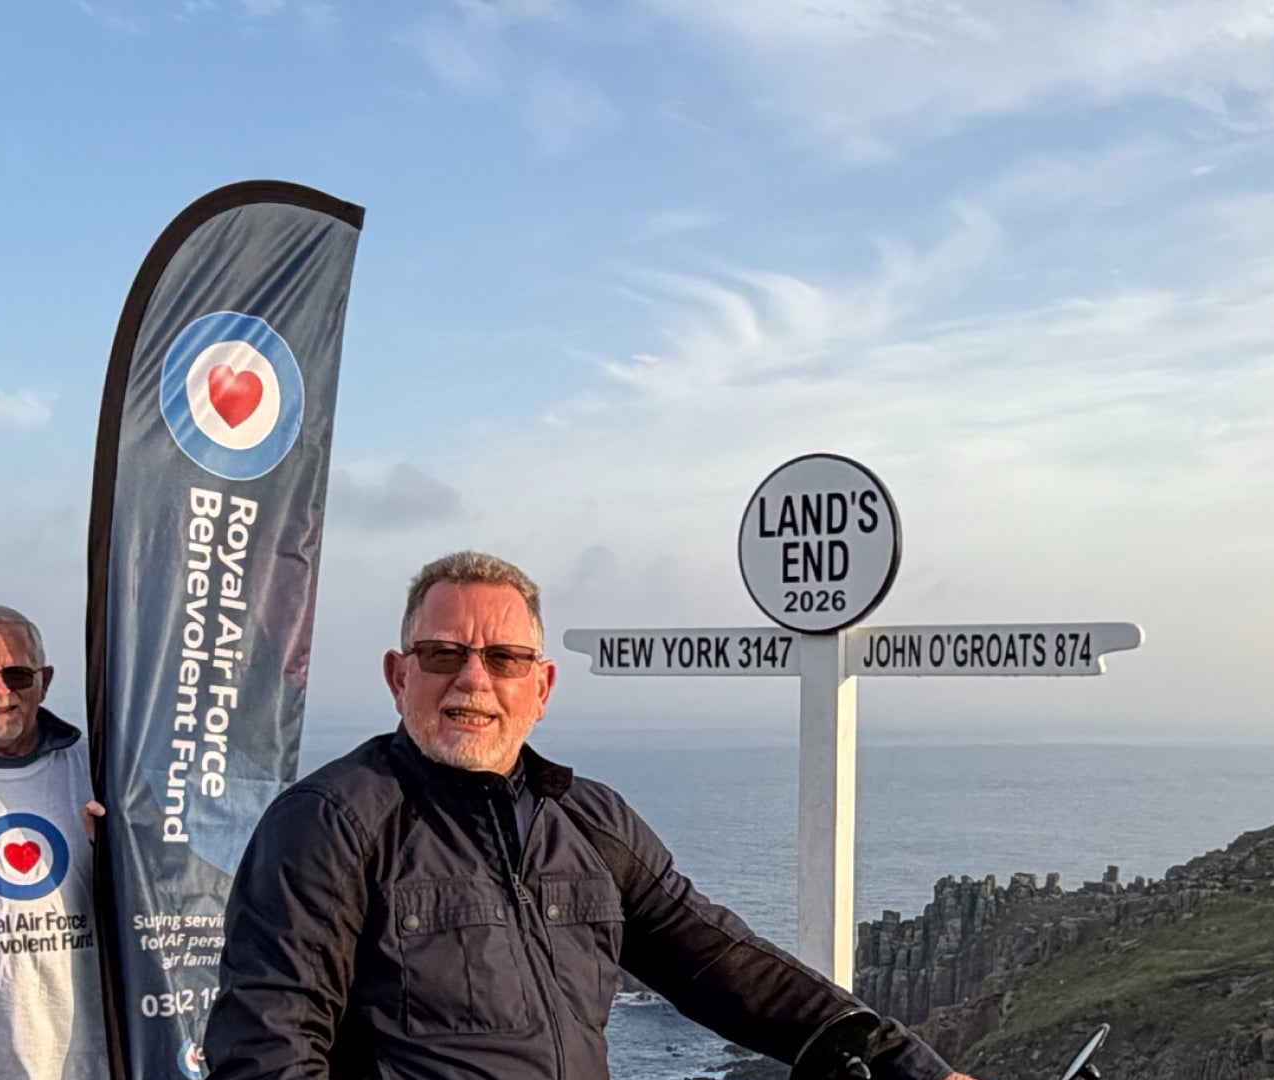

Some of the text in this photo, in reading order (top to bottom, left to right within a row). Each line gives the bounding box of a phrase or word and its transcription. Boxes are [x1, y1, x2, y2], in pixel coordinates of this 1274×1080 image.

[759, 490, 878, 538] LAND'S
[782, 540, 849, 583] END
[784, 590, 846, 612] 2026
[162, 487, 223, 843] Benevolent Fund
[201, 495, 259, 798] Royal Air Force
[600, 636, 793, 668] NEW YORK 3147
[863, 632, 1091, 668] JOHN O'GROATS 874
[15, 911, 43, 932] Air
[45, 911, 87, 931] Force
